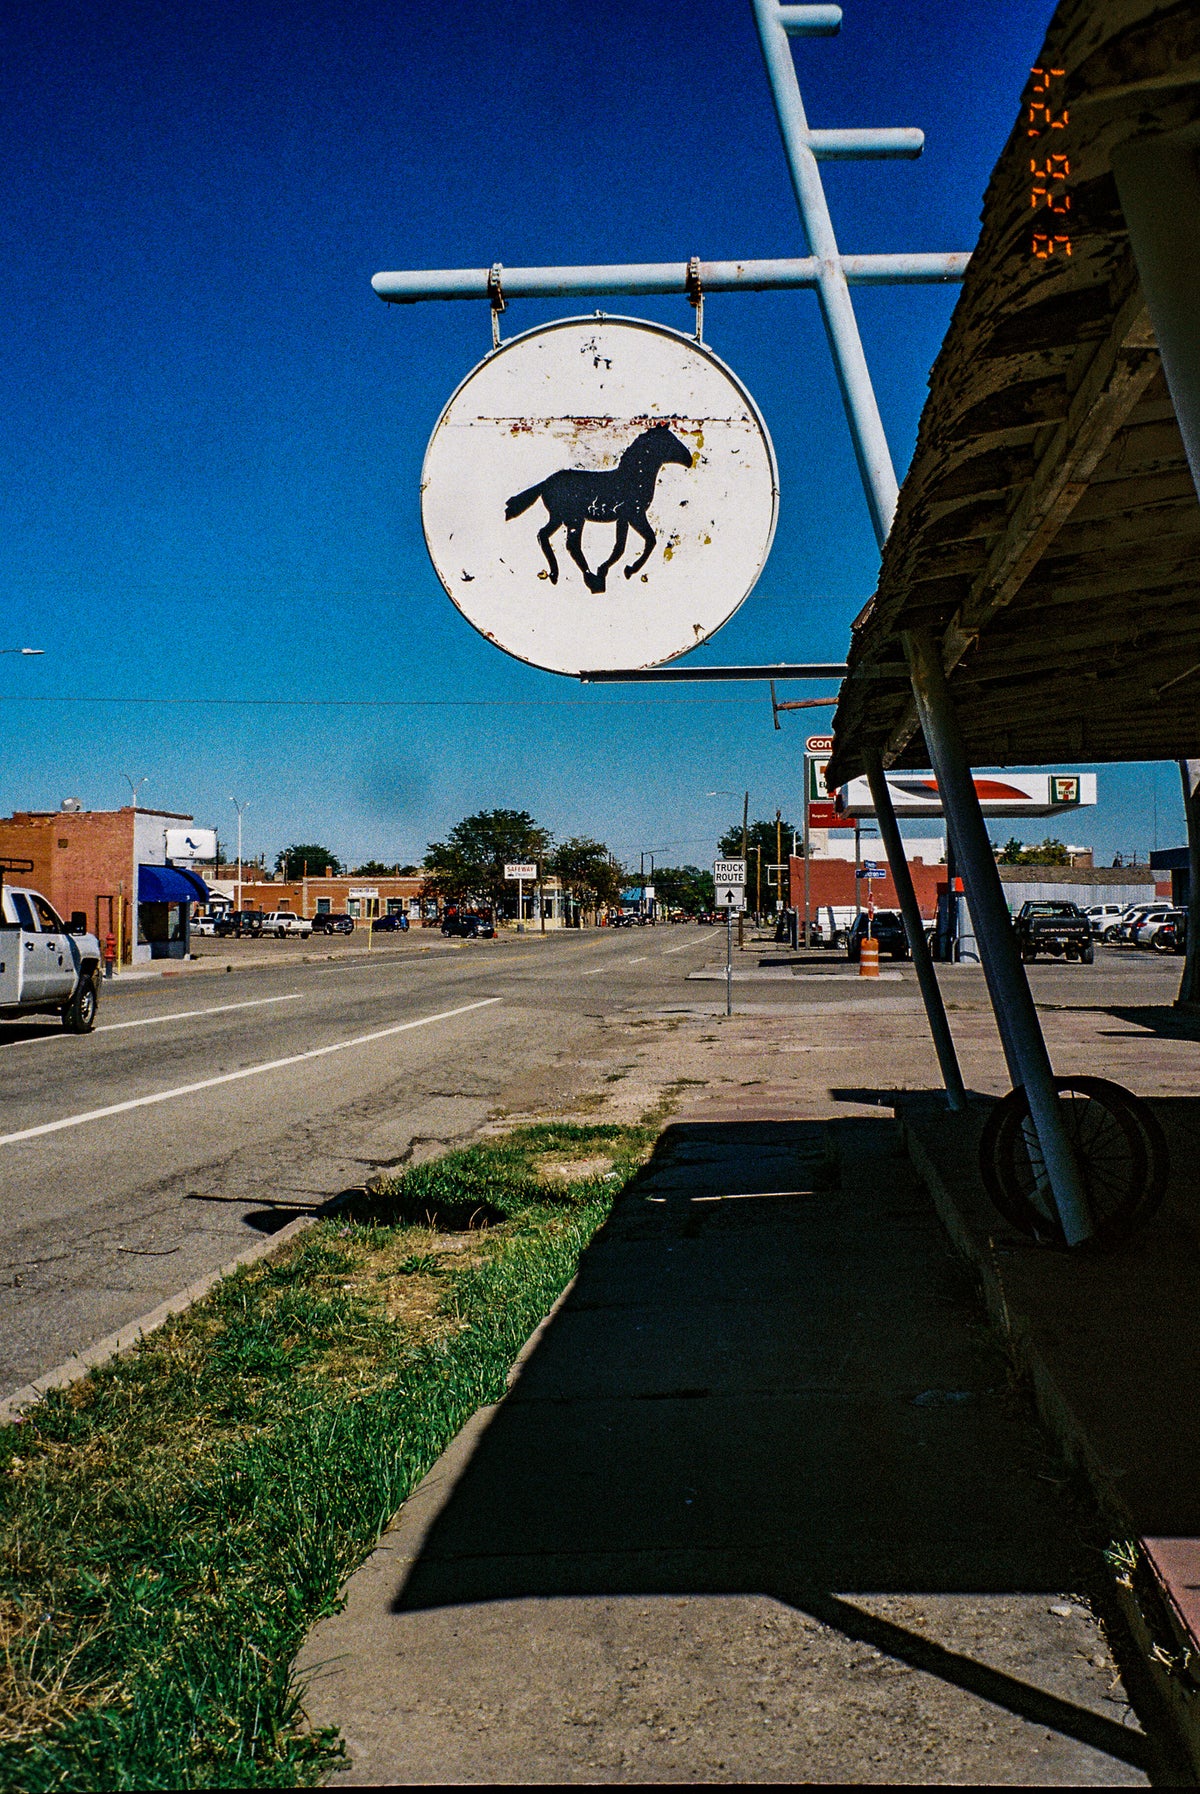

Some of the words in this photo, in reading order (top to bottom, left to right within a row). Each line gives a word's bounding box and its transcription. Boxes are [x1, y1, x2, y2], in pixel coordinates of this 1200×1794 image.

[810, 740, 832, 748] con
[716, 863, 744, 872] TRUCK
[716, 873, 744, 881] ROUTE
